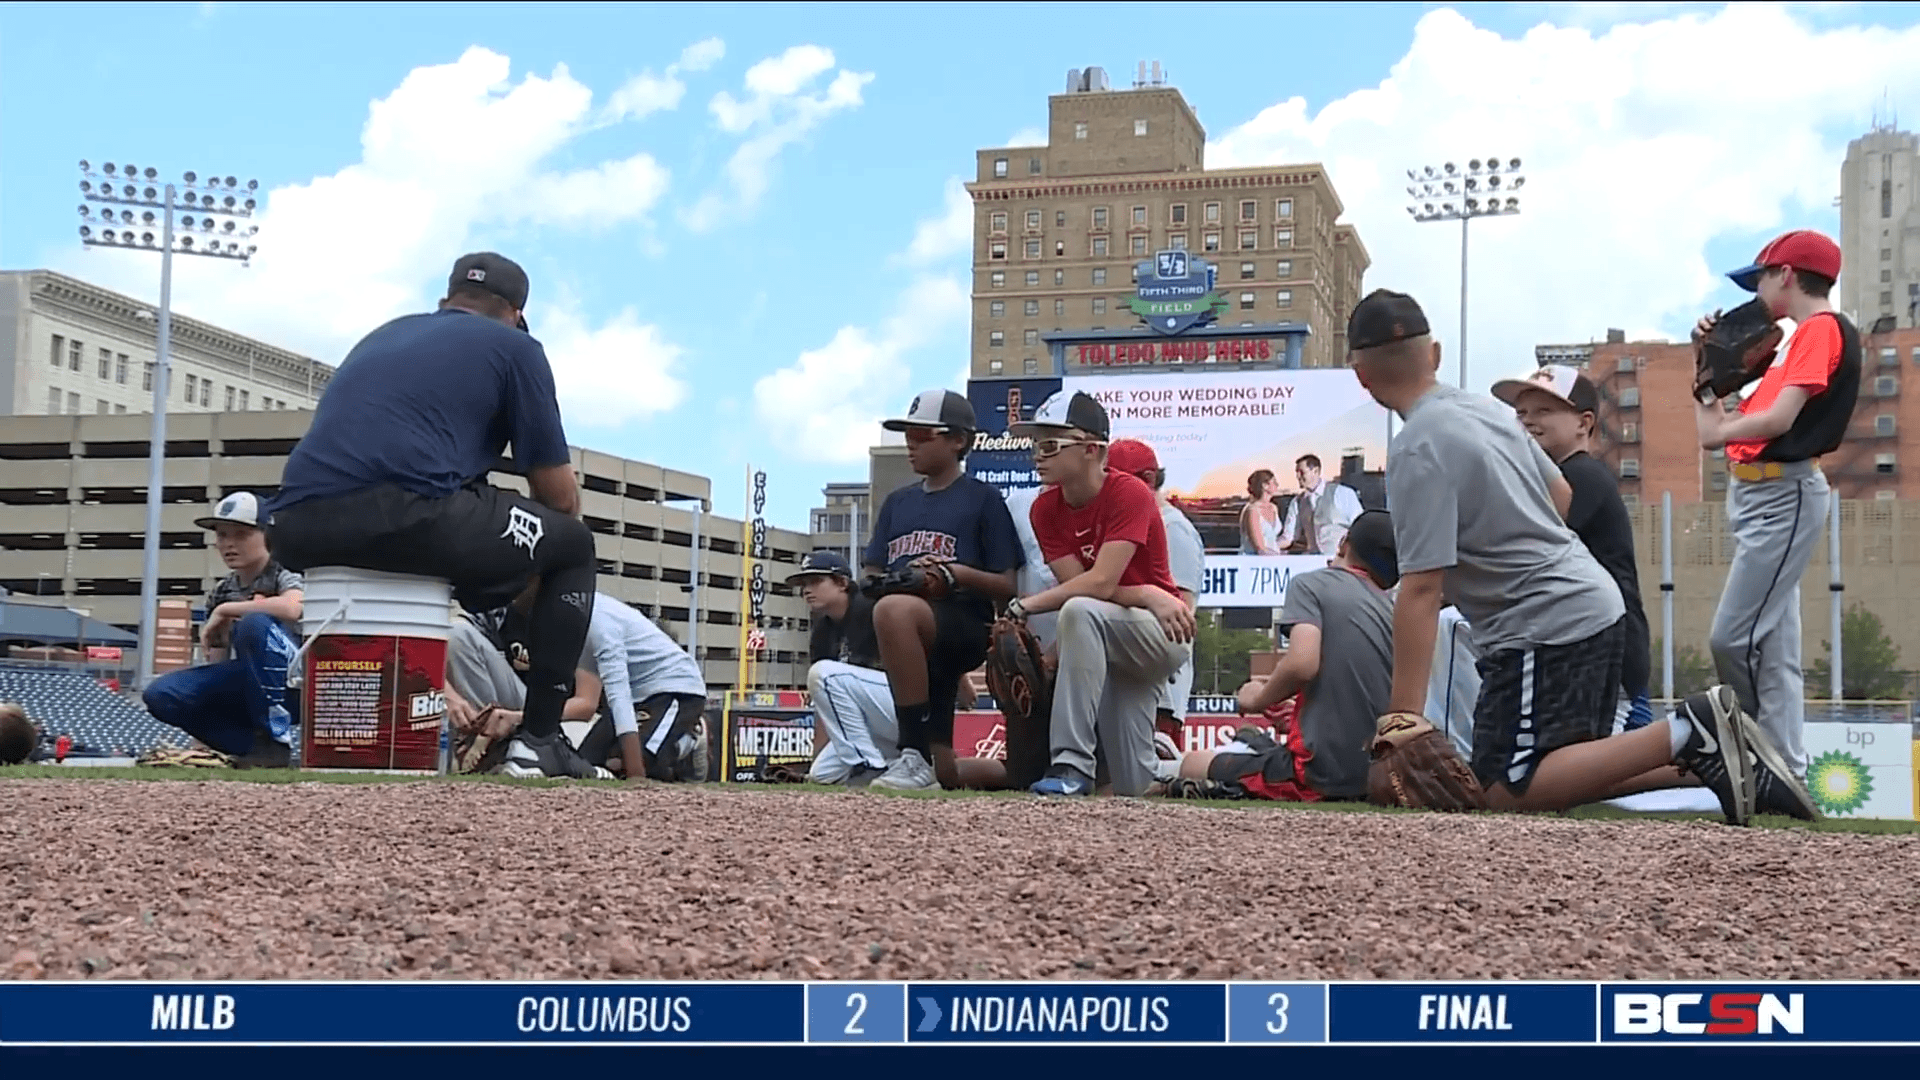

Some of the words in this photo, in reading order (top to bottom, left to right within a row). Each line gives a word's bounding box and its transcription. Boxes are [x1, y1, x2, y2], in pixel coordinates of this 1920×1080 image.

[1139, 287, 1169, 296] FIFTH
[1170, 285, 1204, 295] THIRD
[1151, 303, 1192, 312] FIELD
[1079, 343, 1155, 365] TOLEDO
[1161, 341, 1208, 362] MUD
[1215, 338, 1270, 360] HENS
[1093, 391, 1123, 404] AKE
[1130, 389, 1173, 402] YOUR
[1179, 387, 1257, 401] WEDDING
[1263, 386, 1294, 400] DAY
[1127, 405, 1172, 418] MORE
[1178, 403, 1285, 417] MEMORABLE!
[973, 431, 1033, 451] Fleetwo
[988, 470, 1009, 482] Craft
[1011, 470, 1030, 482] Beer
[755, 472, 766, 514] EAT
[1200, 567, 1239, 594] GHT
[1251, 567, 1290, 594] 7PM
[752, 565, 764, 620] FOWL
[1196, 699, 1234, 711] RUN
[739, 727, 814, 756] METZGERS
[1182, 725, 1236, 750] HIS
[1846, 727, 1875, 749] bp
